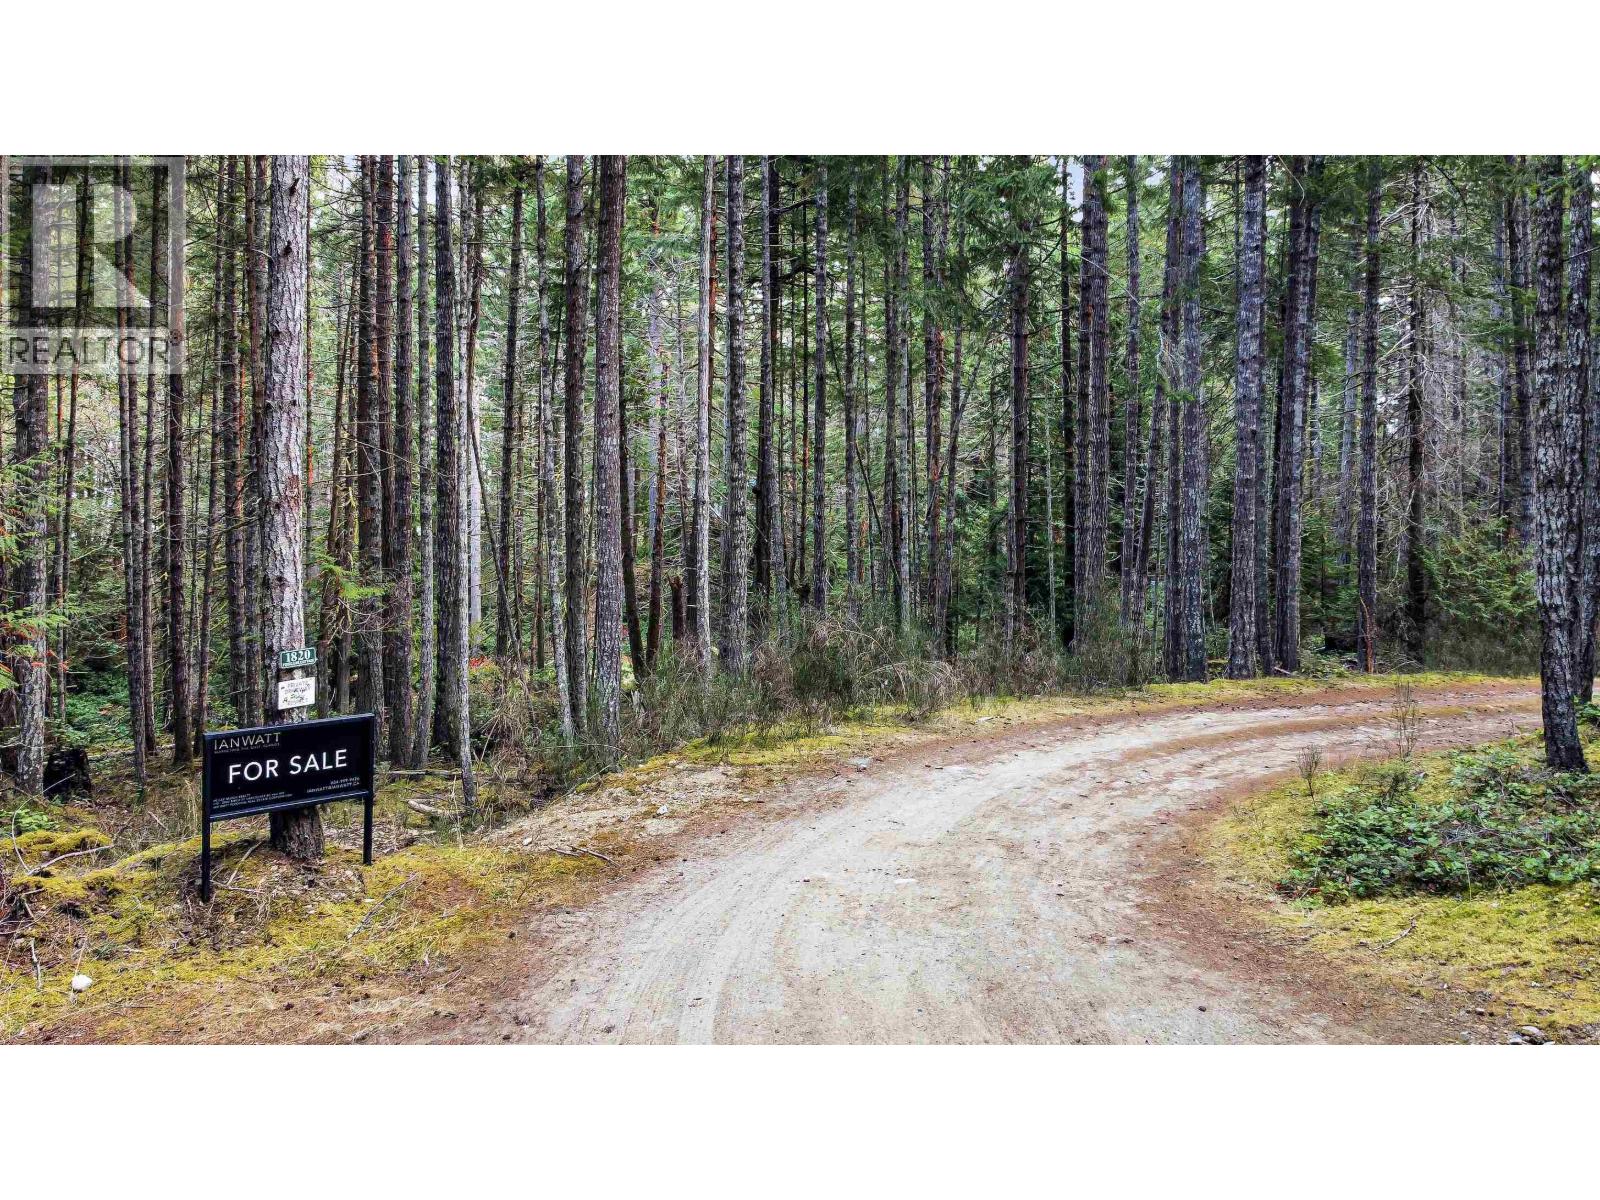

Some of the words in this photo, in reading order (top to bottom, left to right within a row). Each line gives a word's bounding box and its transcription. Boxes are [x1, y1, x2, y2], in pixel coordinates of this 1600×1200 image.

[285, 649, 311, 663] 1820
[228, 759, 279, 784] FOR
[289, 749, 347, 775] SALE
